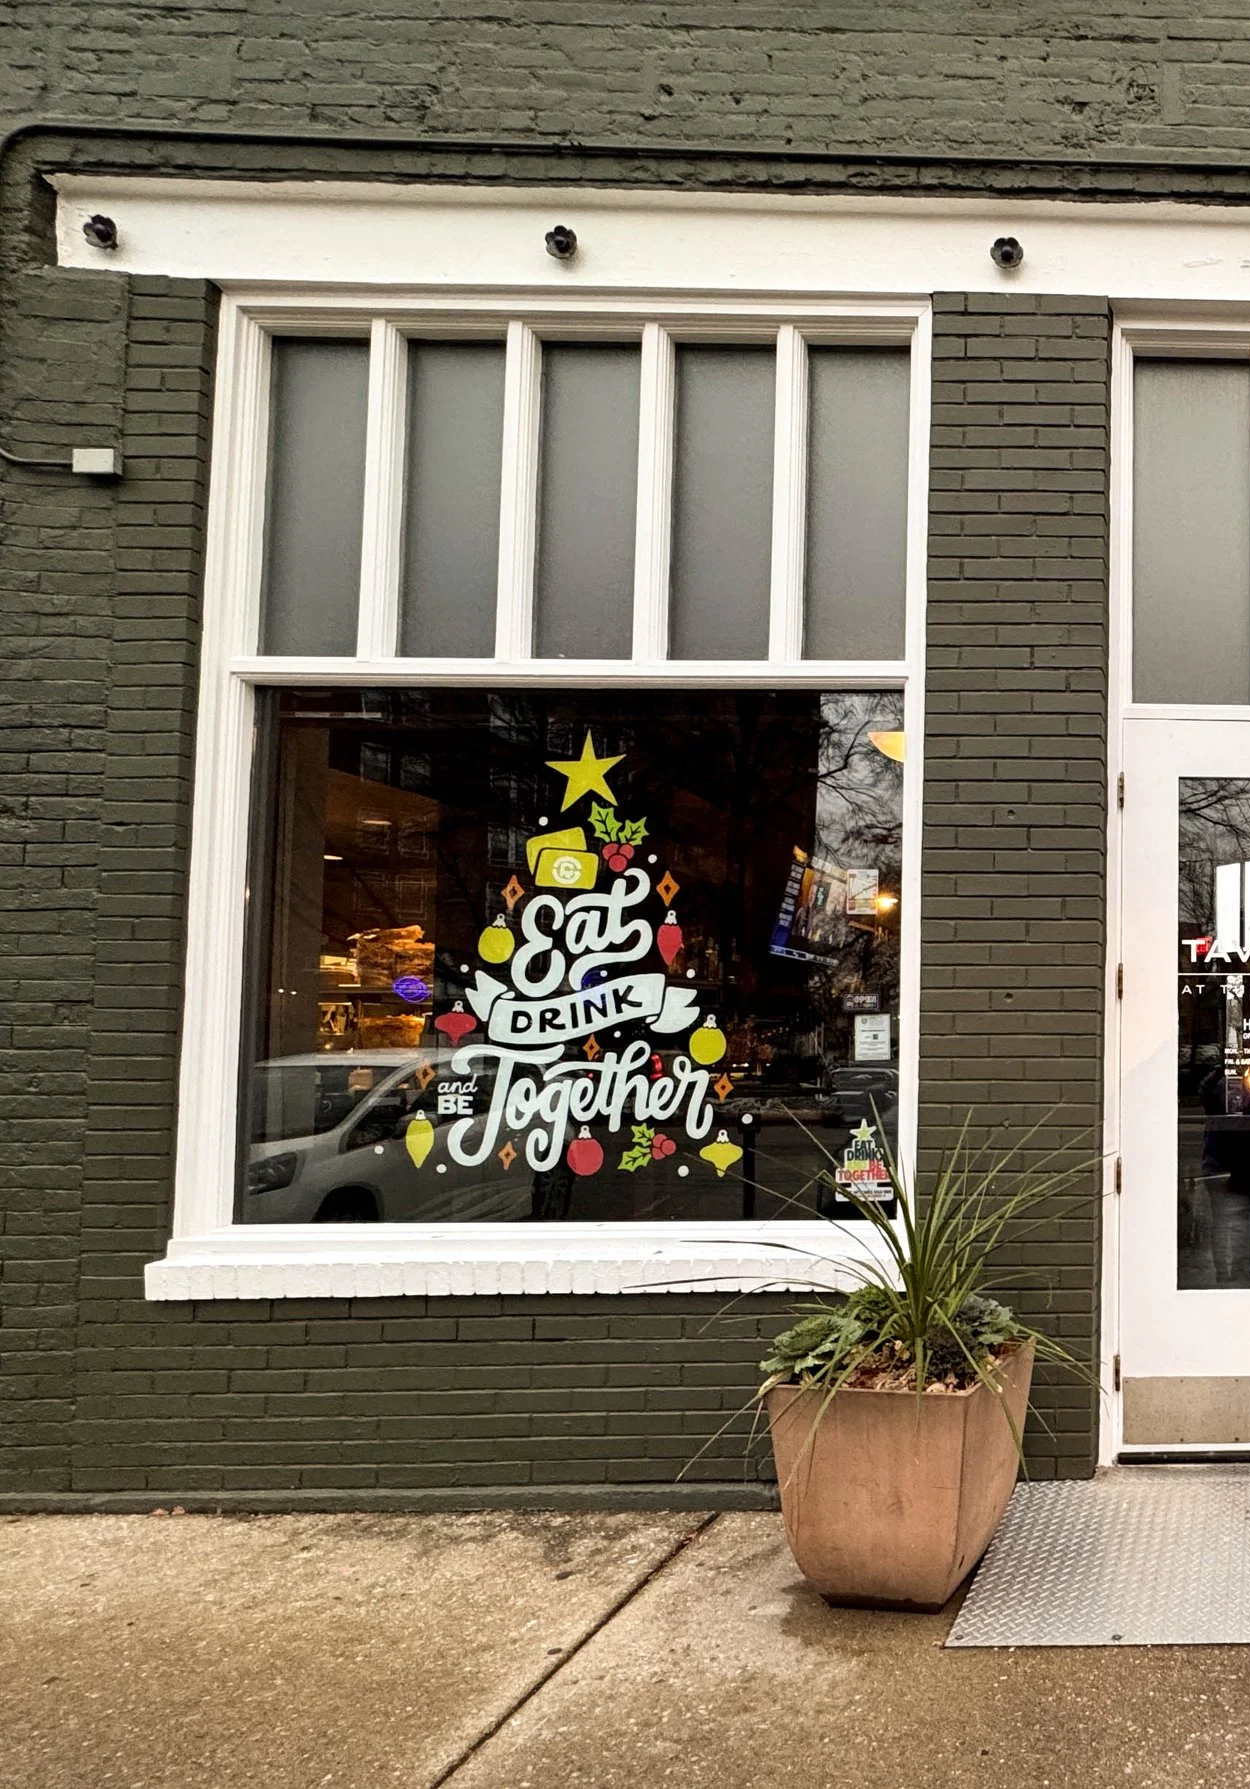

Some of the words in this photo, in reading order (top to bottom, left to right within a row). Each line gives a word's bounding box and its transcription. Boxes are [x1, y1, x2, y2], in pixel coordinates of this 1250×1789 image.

[510, 867, 653, 998] Eat
[1181, 984, 1206, 995] AT
[510, 985, 643, 1034] DRINK
[437, 1073, 479, 1094] and
[437, 1095, 474, 1115] BE
[447, 1040, 714, 1173] Together
[854, 1140, 873, 1150] EAT
[869, 1160, 883, 1170] BE
